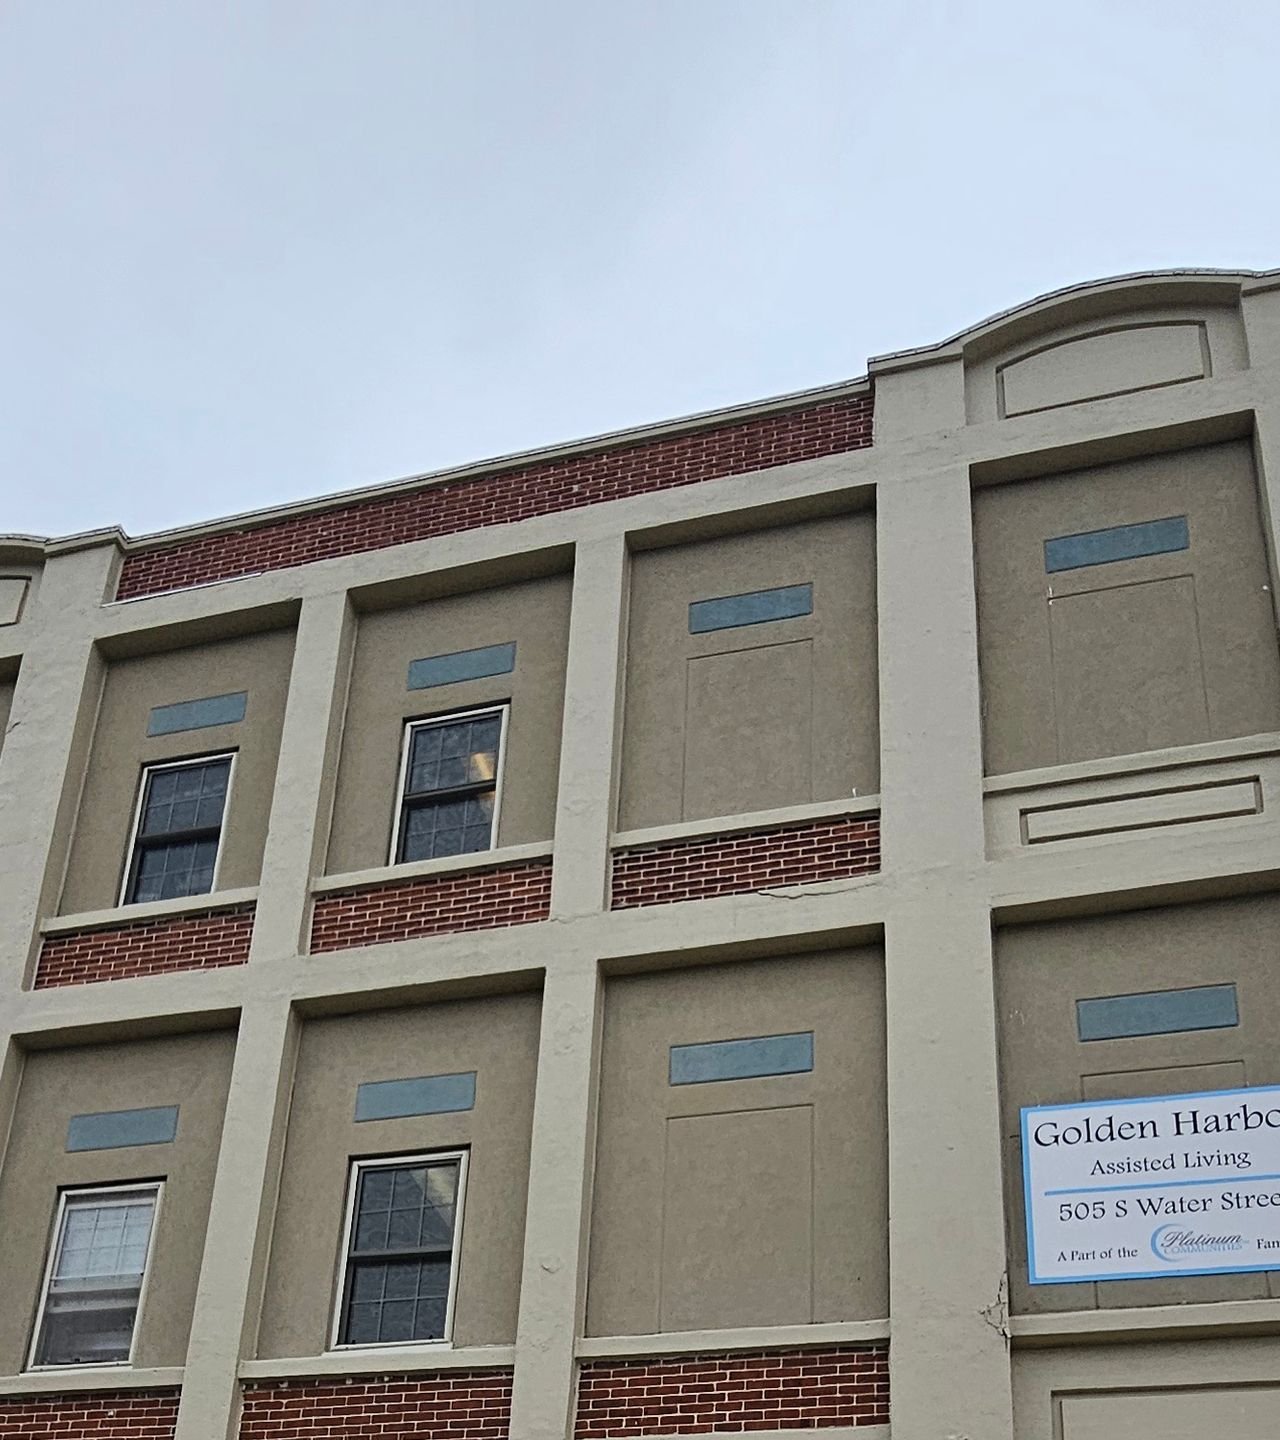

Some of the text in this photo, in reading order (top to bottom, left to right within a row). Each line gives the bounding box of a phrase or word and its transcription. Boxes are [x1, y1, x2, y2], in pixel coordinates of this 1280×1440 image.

[1034, 1116, 1159, 1147] Golden
[1090, 1150, 1251, 1176] Assisted Living
[1059, 1201, 1106, 1222] 505
[1115, 1200, 1127, 1218] S
[1137, 1195, 1212, 1217] Water
[1058, 1251, 1067, 1262] A
[1071, 1250, 1096, 1261] Part
[1100, 1247, 1113, 1259] of
[1117, 1246, 1138, 1258] the
[1161, 1231, 1241, 1248] Platinum
